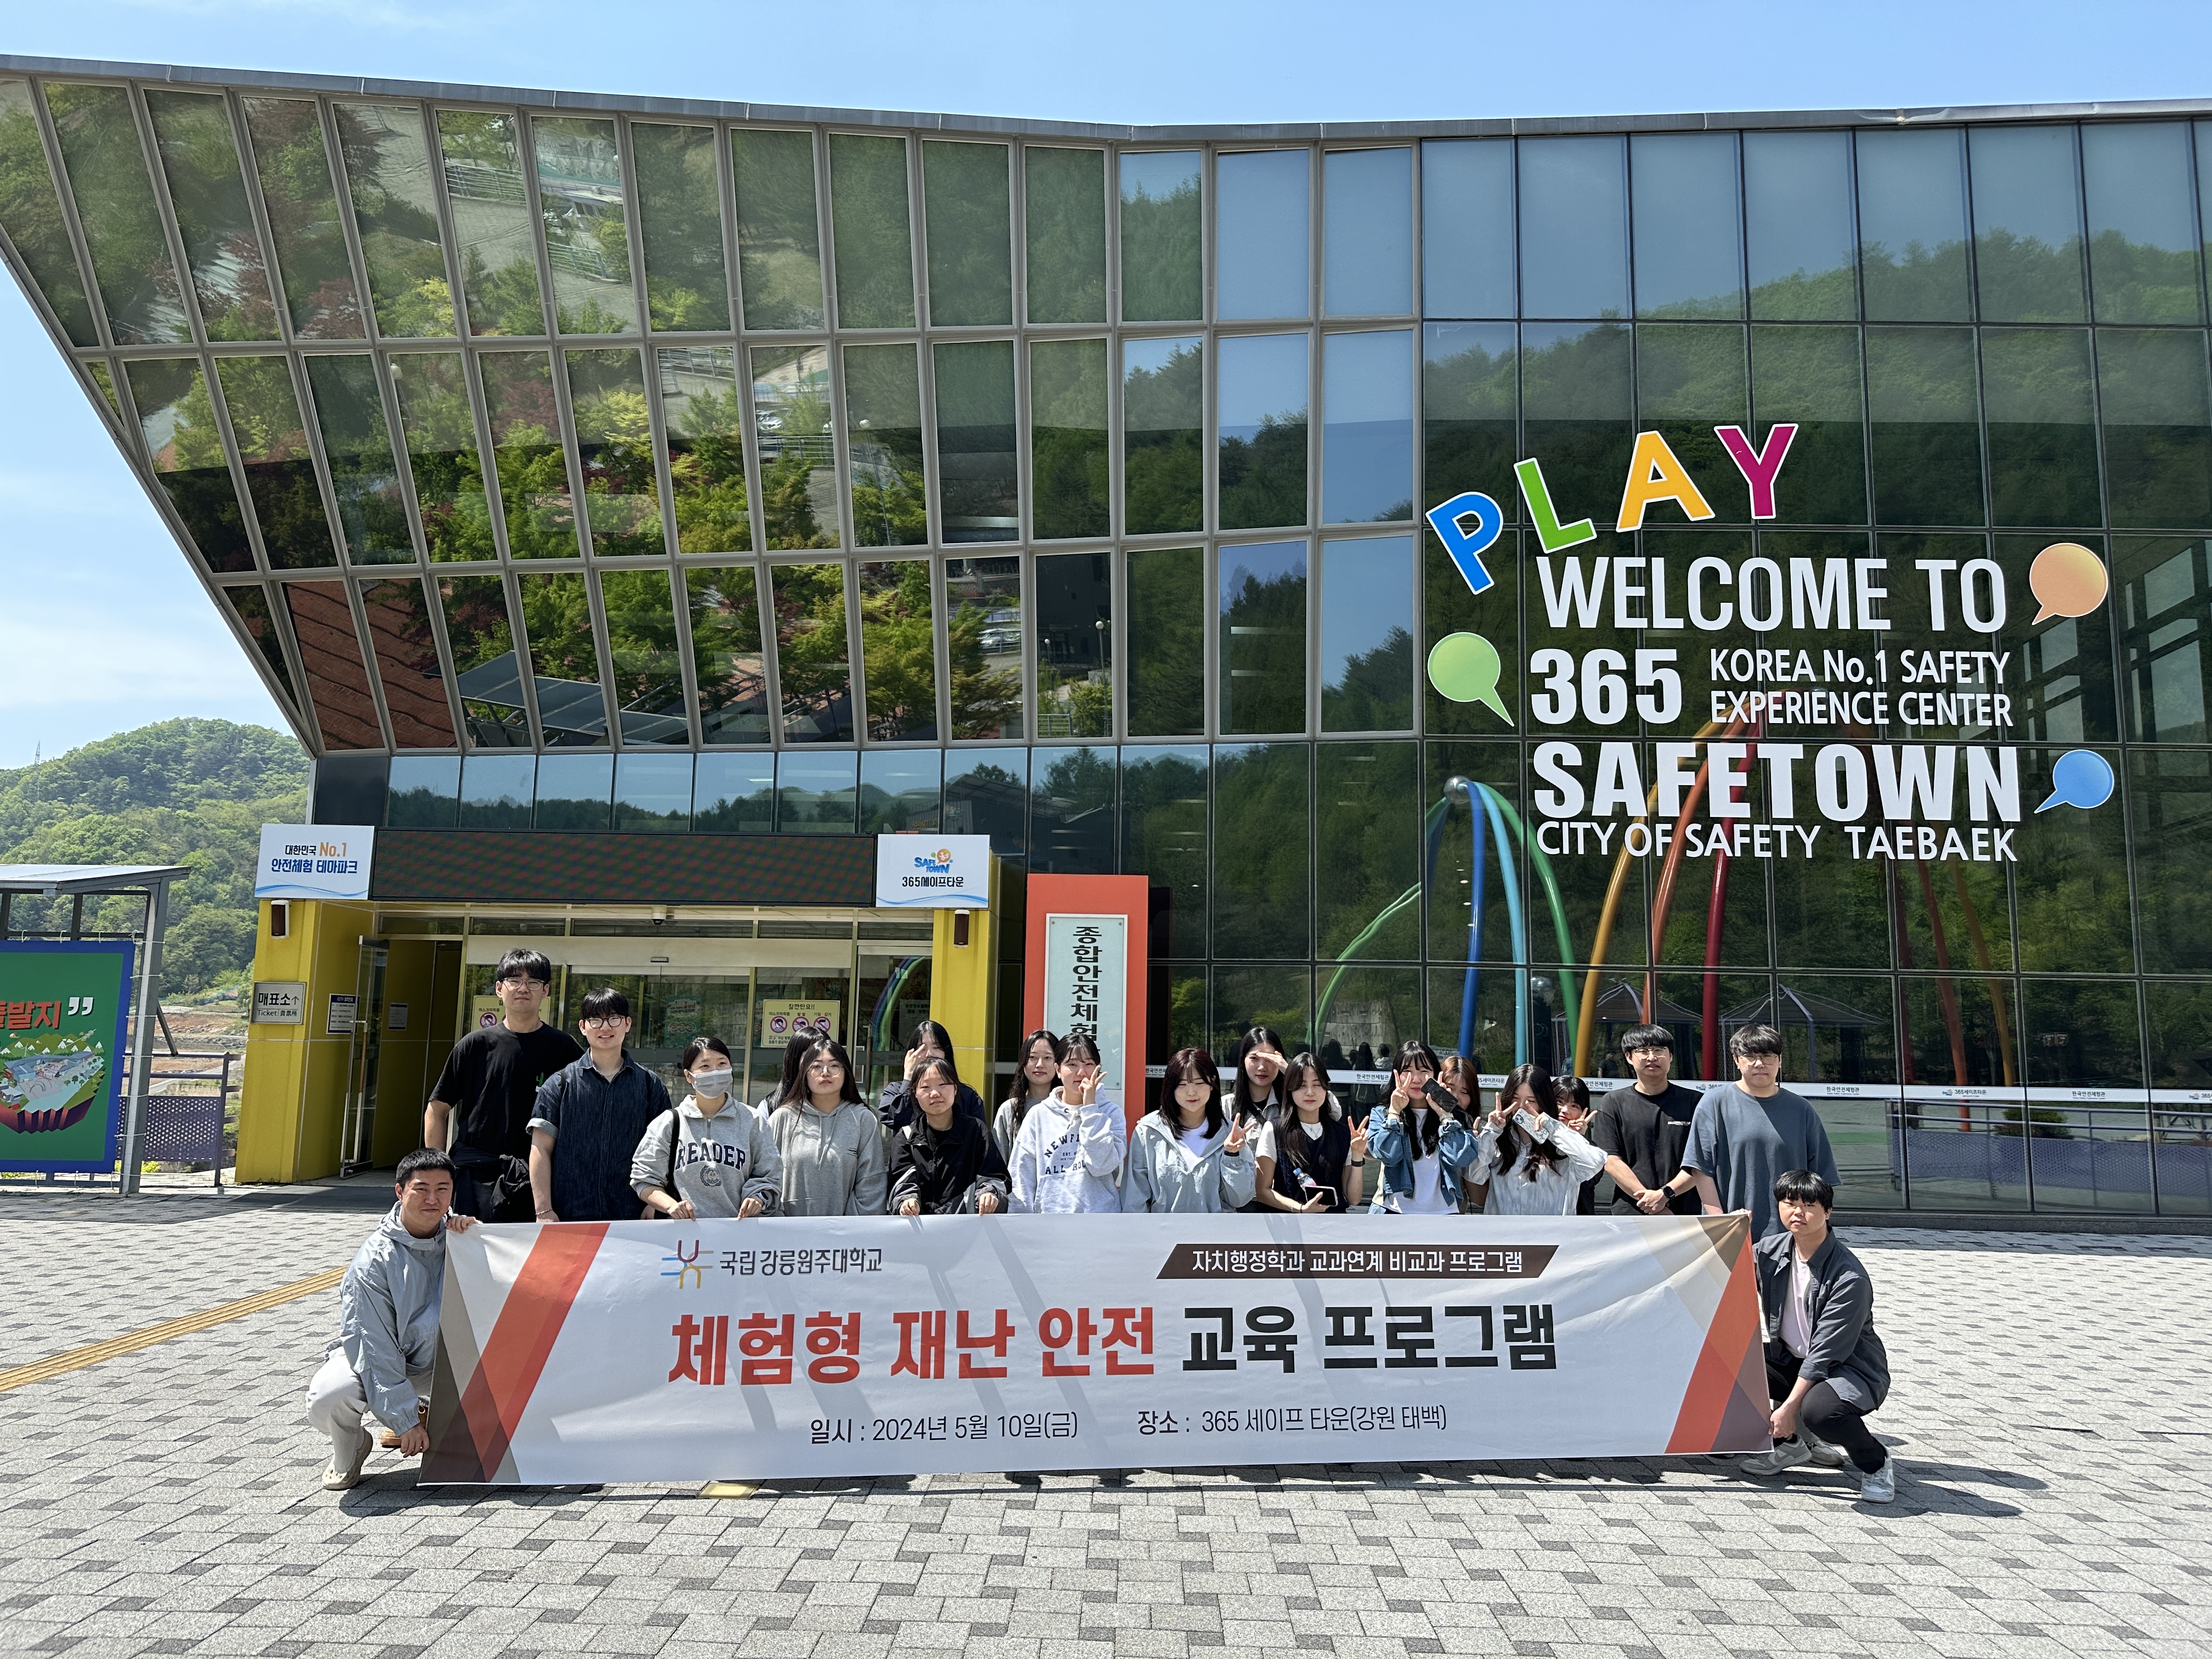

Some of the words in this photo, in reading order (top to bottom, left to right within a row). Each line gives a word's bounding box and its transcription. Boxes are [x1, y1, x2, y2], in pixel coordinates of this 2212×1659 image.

[1425, 424, 1798, 595] PLAY
[1537, 556, 1891, 630] WELCOME
[1915, 558, 2007, 633] TO
[1711, 648, 1815, 682] KOREA
[1824, 651, 1888, 686] No.1
[1900, 652, 2010, 685] SAFETY
[1530, 648, 1681, 725] 365
[1711, 692, 1889, 725] EXPERIENCE
[1899, 693, 2013, 727] CENTER
[1534, 742, 2021, 823] SAFETOWN
[285, 845, 317, 856] 대한민국
[319, 842, 347, 857] No.1
[1538, 821, 1617, 857] CITY
[1624, 822, 1674, 857] OF
[1686, 823, 1821, 859] SAFETY
[1844, 826, 2017, 862] TAEBAEK
[272, 859, 313, 873] 안전체험
[316, 860, 358, 874] 테마파크
[914, 857, 936, 868] SAFE
[926, 864, 950, 874] TOWN
[902, 876, 964, 887] 365세이프타운
[258, 992, 290, 1006] 매표소
[1070, 926, 1103, 1074] 종합안전체험
[675, 1142, 746, 1170] READER
[1045, 1165, 1065, 1174] ALL
[1073, 1160, 1086, 1171] ROU
[719, 1250, 755, 1277] 국립
[760, 1248, 882, 1276] 강릉원주대학교
[1192, 1250, 1306, 1273] 자치행정학과
[1311, 1250, 1383, 1273] 교과연계
[1390, 1250, 1444, 1273] 비교과
[1449, 1250, 1522, 1273] 프로그램
[668, 1311, 861, 1386] 체험형
[890, 1309, 1015, 1380] 재난
[1037, 1307, 1154, 1376] 안전
[1182, 1306, 1299, 1374] 교육
[1324, 1304, 1557, 1370] 프로그램
[810, 1419, 853, 1445] 일시
[873, 1417, 946, 1442] 2024년
[953, 1414, 989, 1440] 5월
[997, 1412, 1078, 1440] 10일(금)
[1137, 1410, 1178, 1434] 장소
[1202, 1411, 1238, 1432] 365
[1245, 1408, 1304, 1433] 세이프
[1310, 1407, 1395, 1433] 타운(강원
[1402, 1405, 1448, 1432] 태백)
